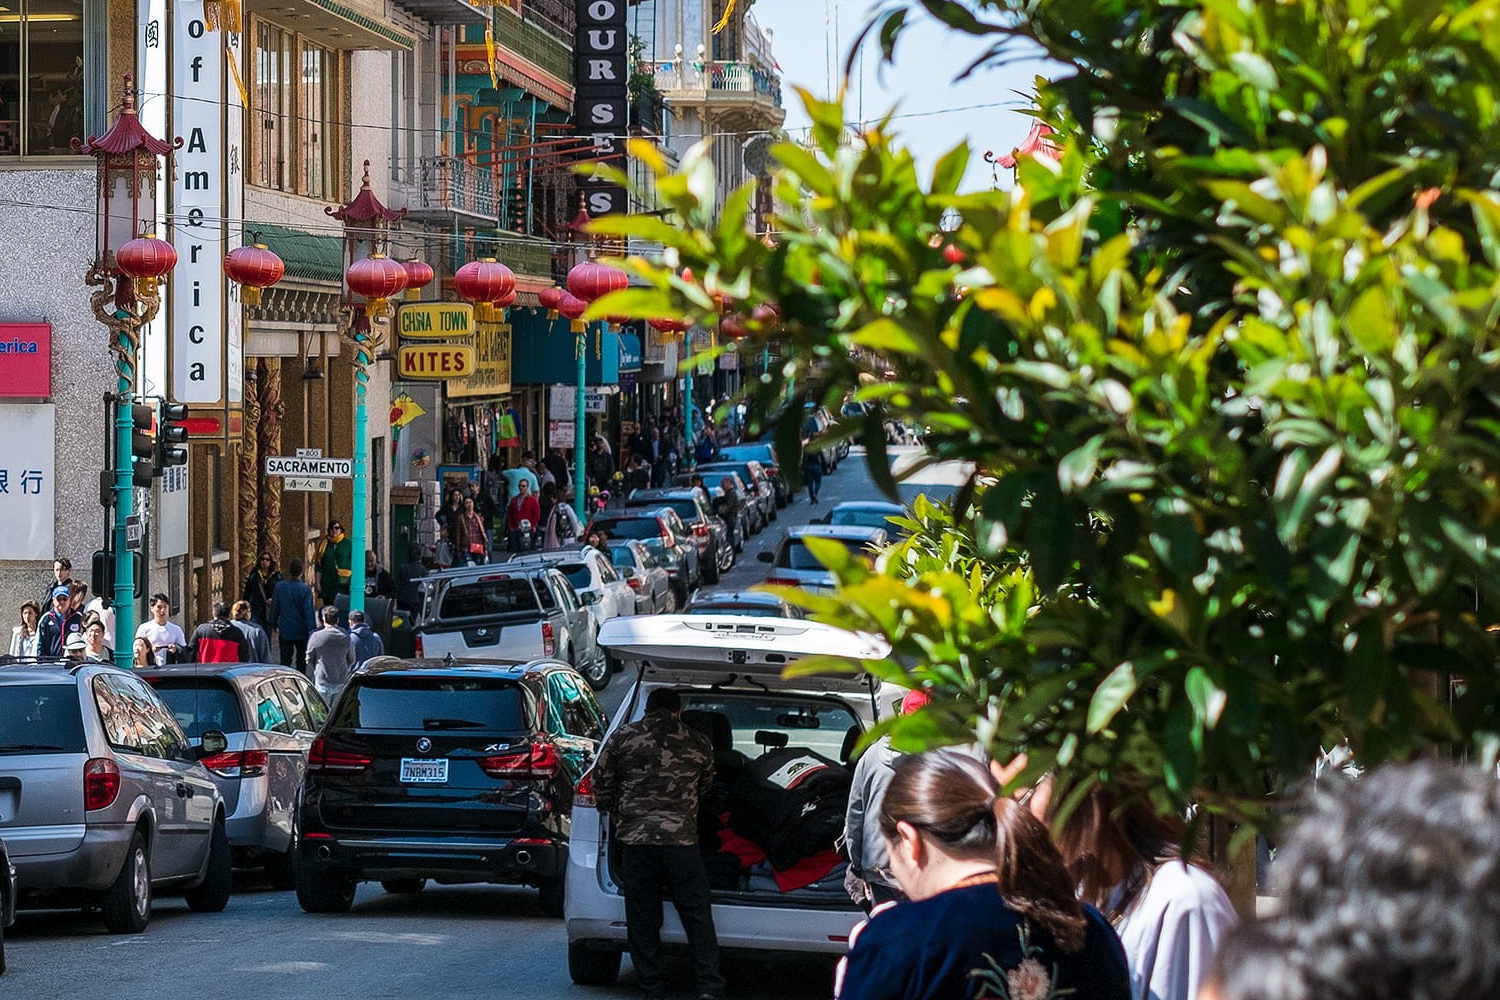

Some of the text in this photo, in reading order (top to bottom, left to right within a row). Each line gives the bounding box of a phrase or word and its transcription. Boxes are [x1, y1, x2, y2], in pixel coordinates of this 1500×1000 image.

[187, 18, 205, 84] of
[184, 127, 210, 383] America
[402, 311, 468, 332] CHINA TOWN
[404, 351, 465, 372] KITES
[268, 460, 350, 474] SACRAMENTO
